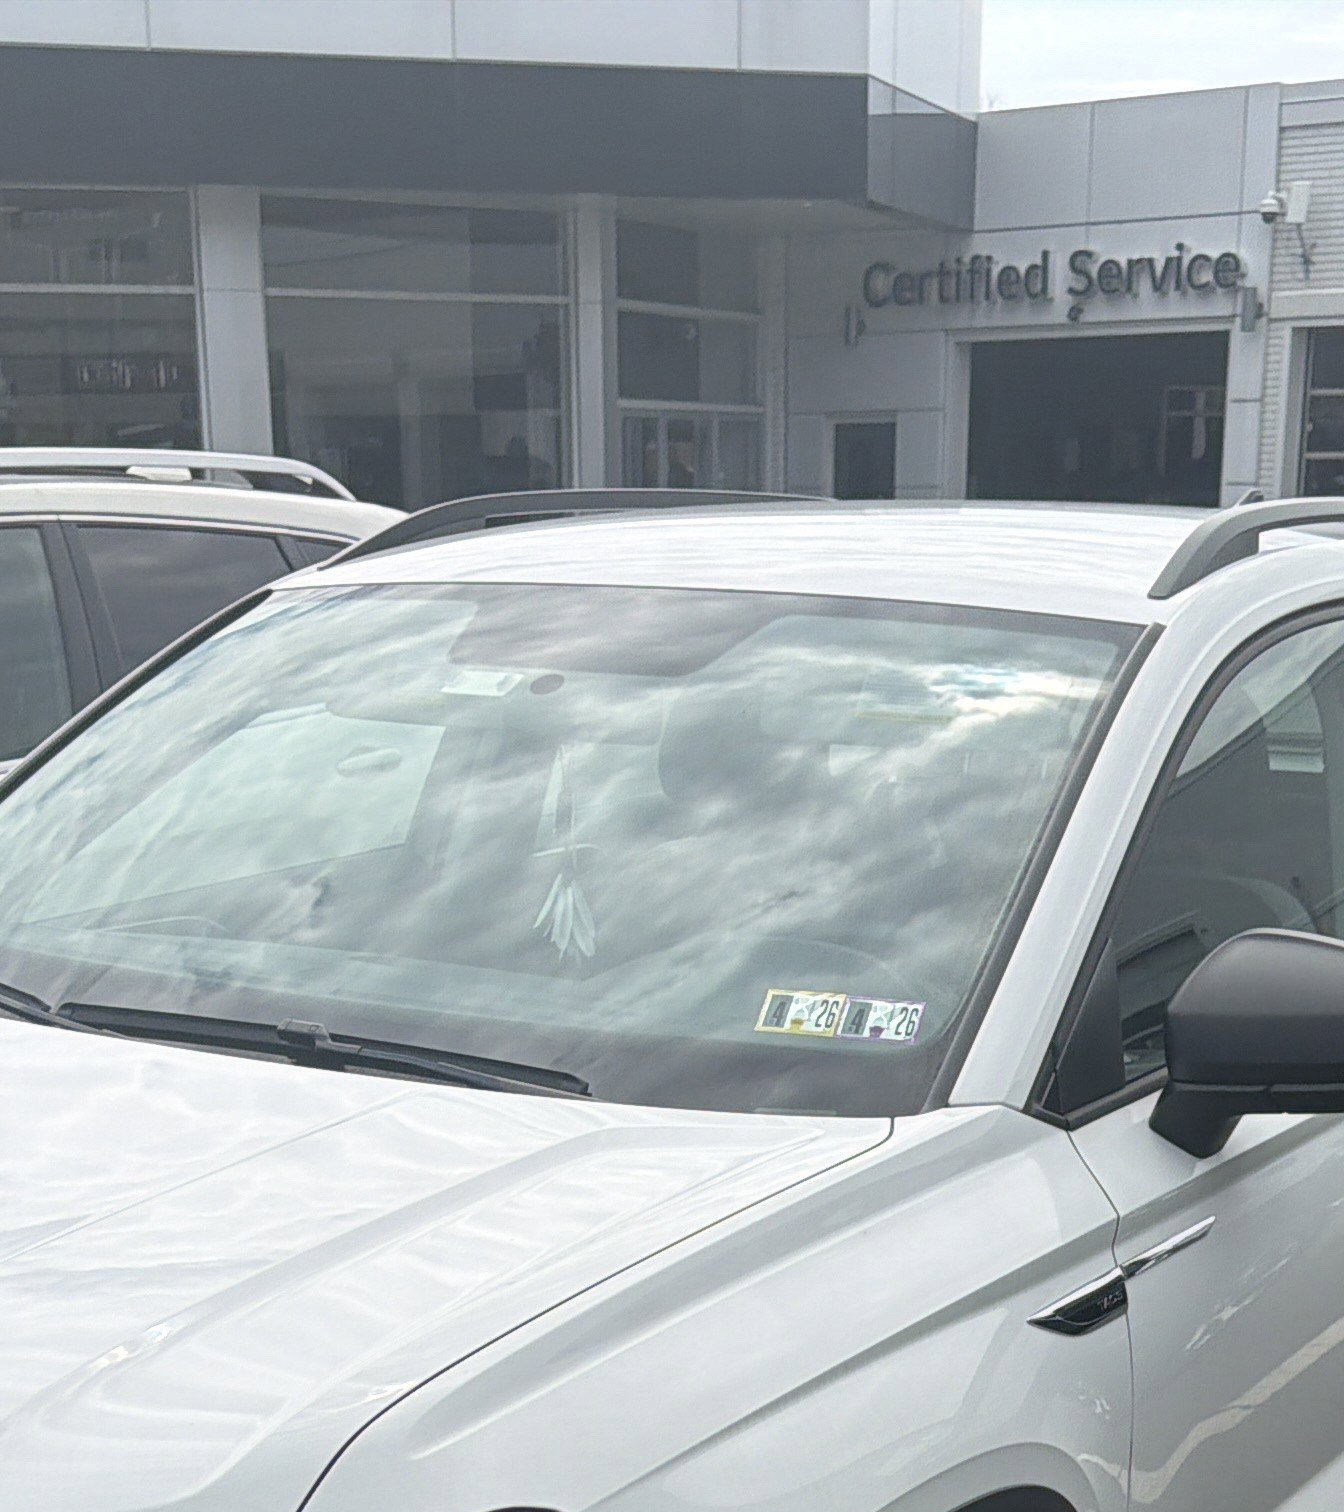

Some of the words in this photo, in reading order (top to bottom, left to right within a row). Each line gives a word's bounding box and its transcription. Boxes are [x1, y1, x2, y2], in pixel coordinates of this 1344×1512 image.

[863, 249, 1051, 306] Certified
[1067, 242, 1242, 298] Service
[772, 1000, 787, 1027] 4
[814, 999, 840, 1028] 26
[851, 1008, 866, 1034] 4
[894, 1006, 920, 1037] 26
